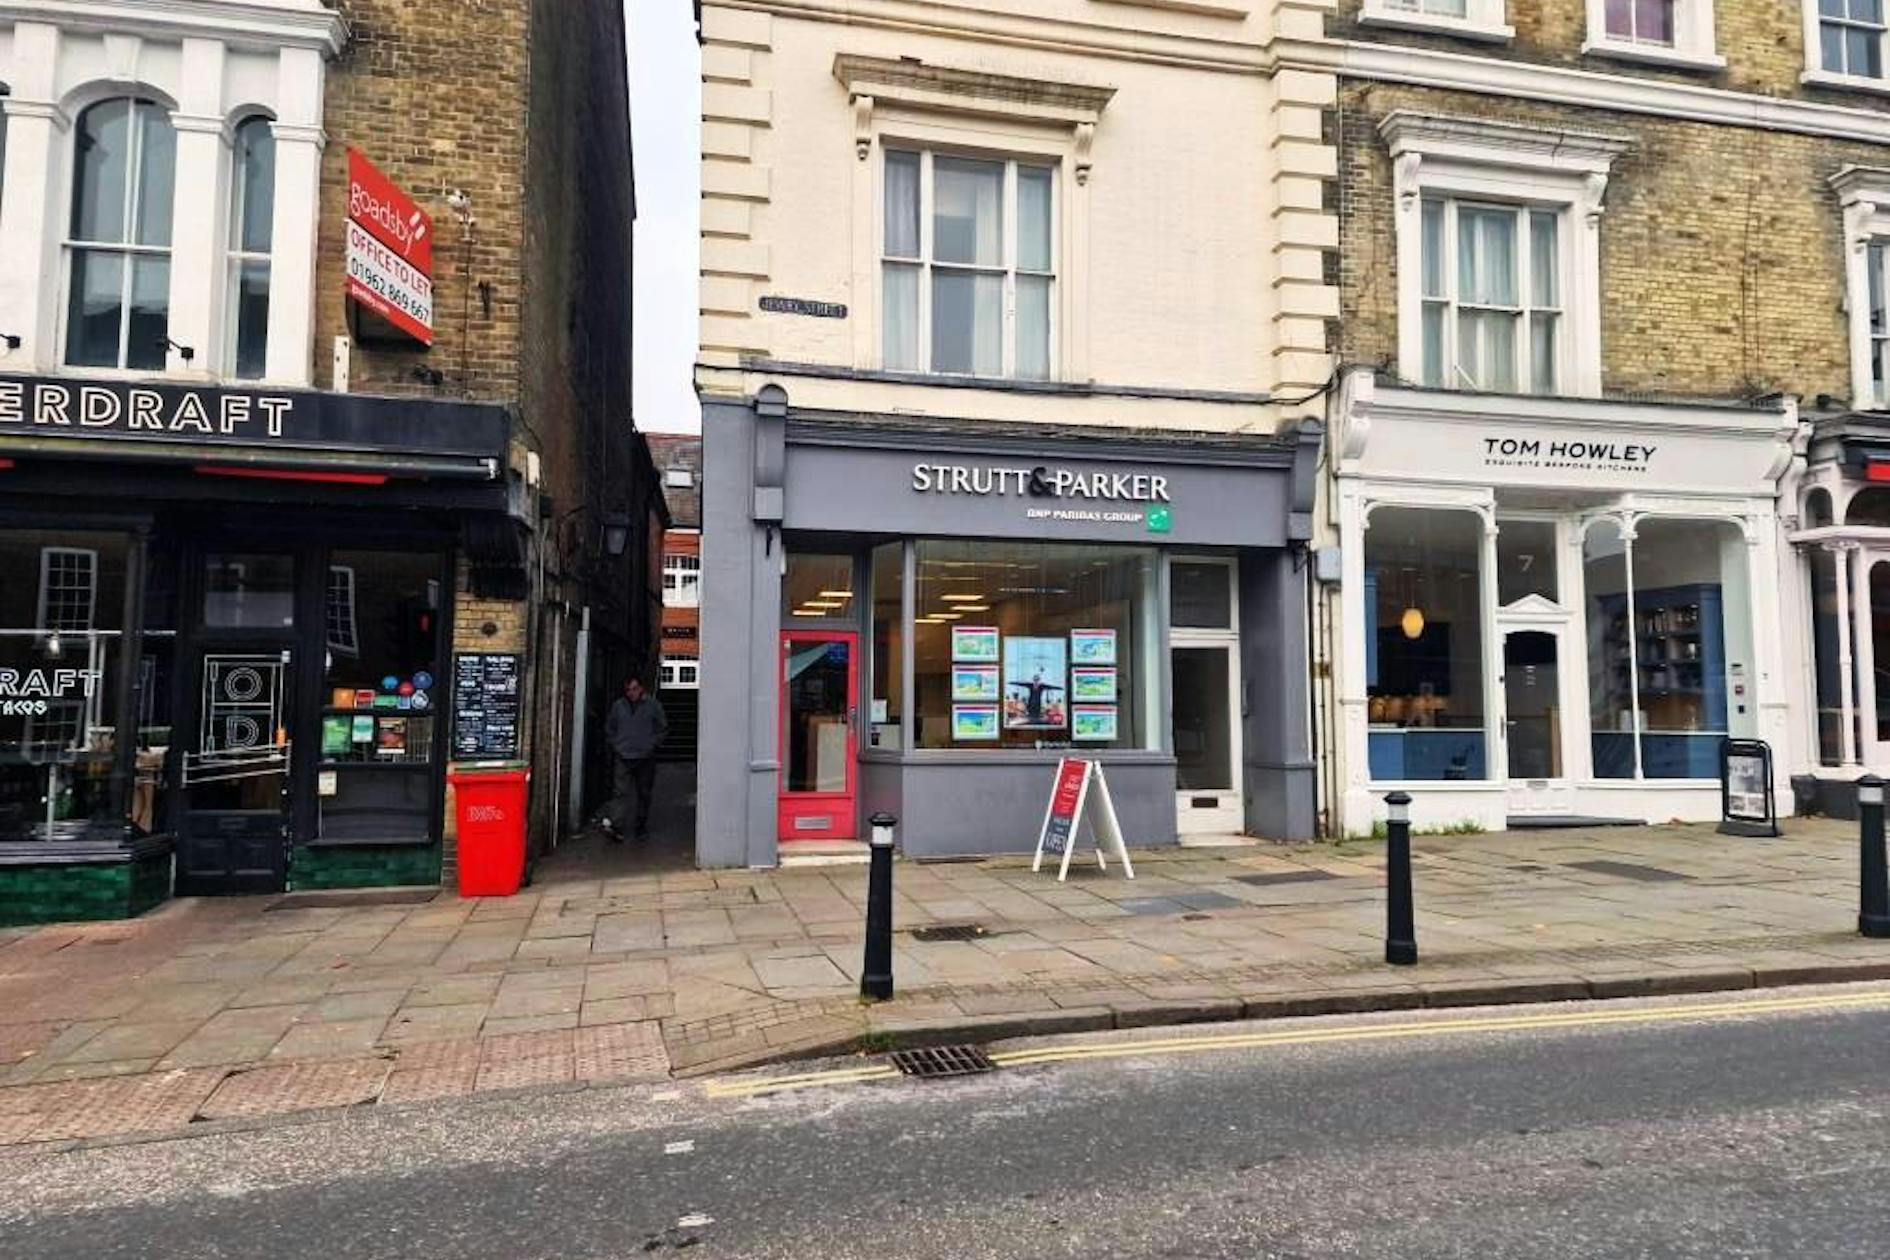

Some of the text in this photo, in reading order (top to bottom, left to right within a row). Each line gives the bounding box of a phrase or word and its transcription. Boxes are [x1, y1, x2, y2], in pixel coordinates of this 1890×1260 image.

[351, 183, 414, 254] goadsby
[352, 230, 392, 272] OFFICE
[394, 259, 409, 285] TO
[411, 275, 429, 299] LET
[352, 257, 387, 297] 01962
[388, 281, 409, 309] 869
[411, 302, 429, 323] 667
[1484, 438, 1657, 462] TOM HOWLEY
[1103, 512, 1143, 522] GROUP
[1517, 554, 1534, 572] 7
